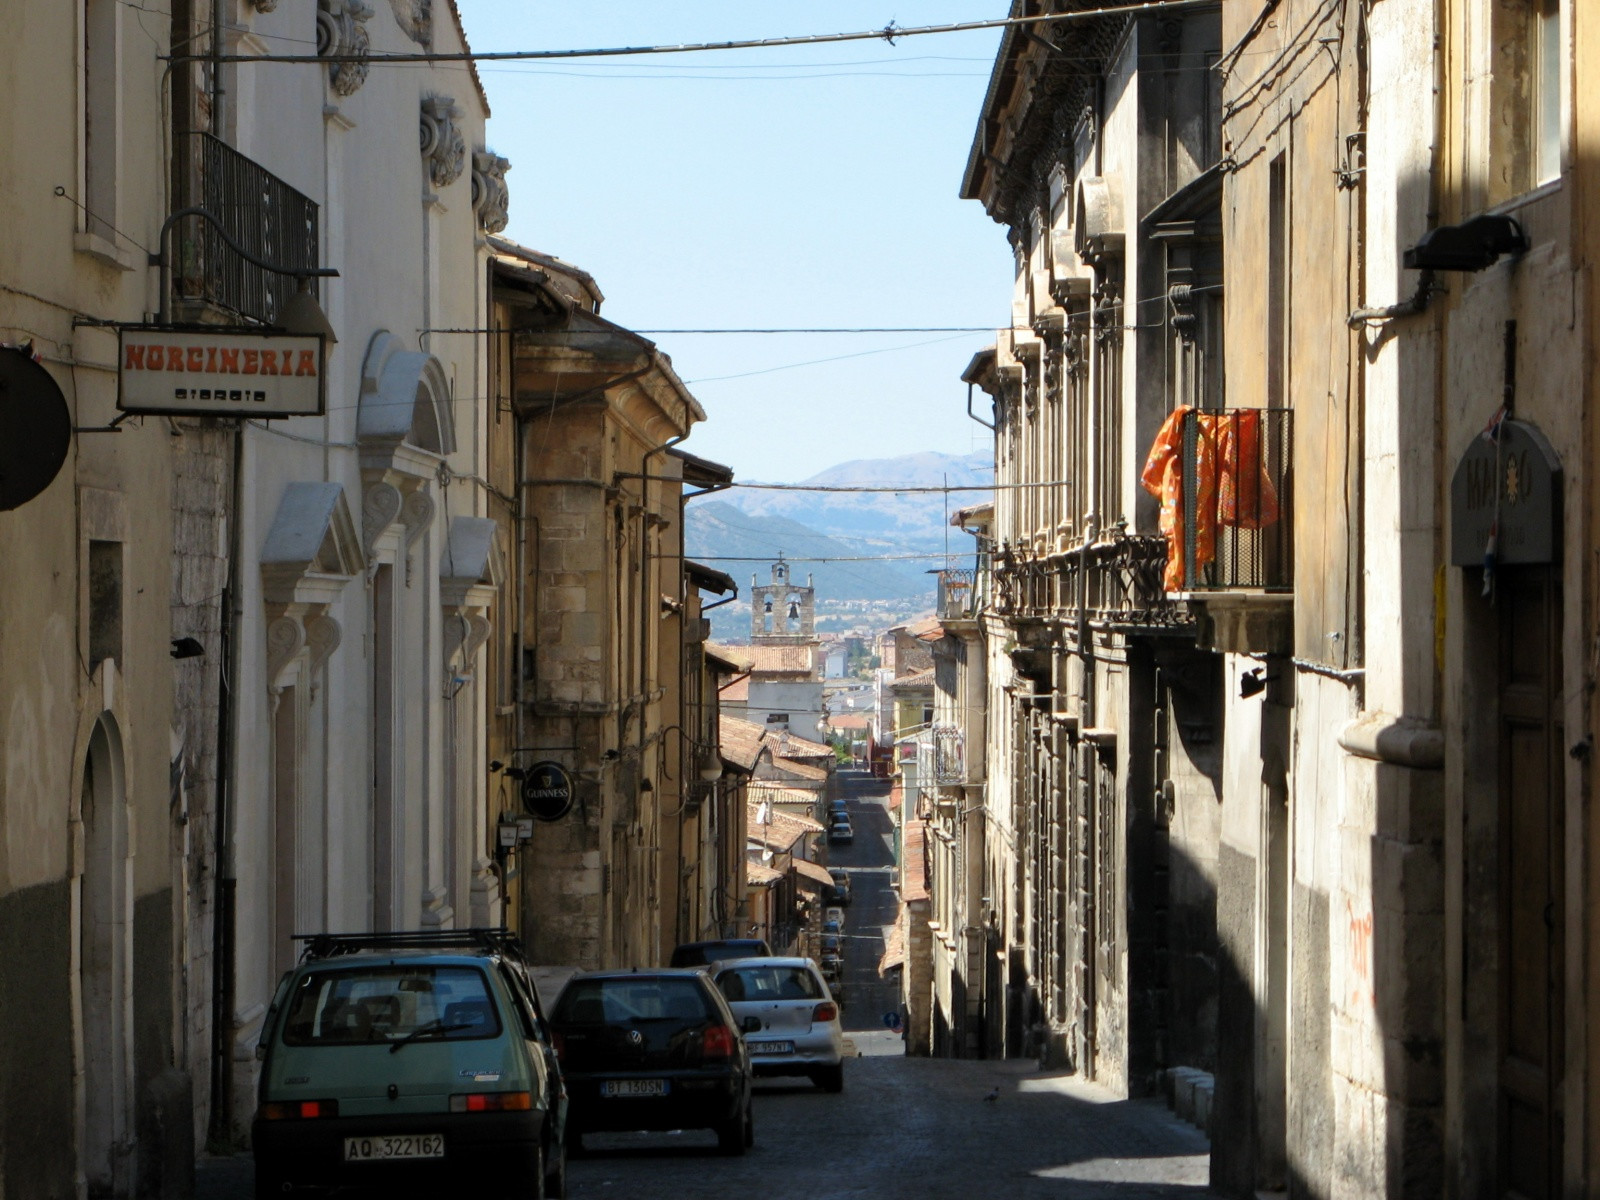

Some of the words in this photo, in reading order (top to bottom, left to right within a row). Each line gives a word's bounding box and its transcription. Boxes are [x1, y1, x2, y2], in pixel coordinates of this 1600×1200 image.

[125, 344, 317, 377] NORCINERIA
[527, 788, 568, 798] GUINNESS
[349, 1140, 371, 1158] AQ
[384, 1136, 442, 1156] 322162
